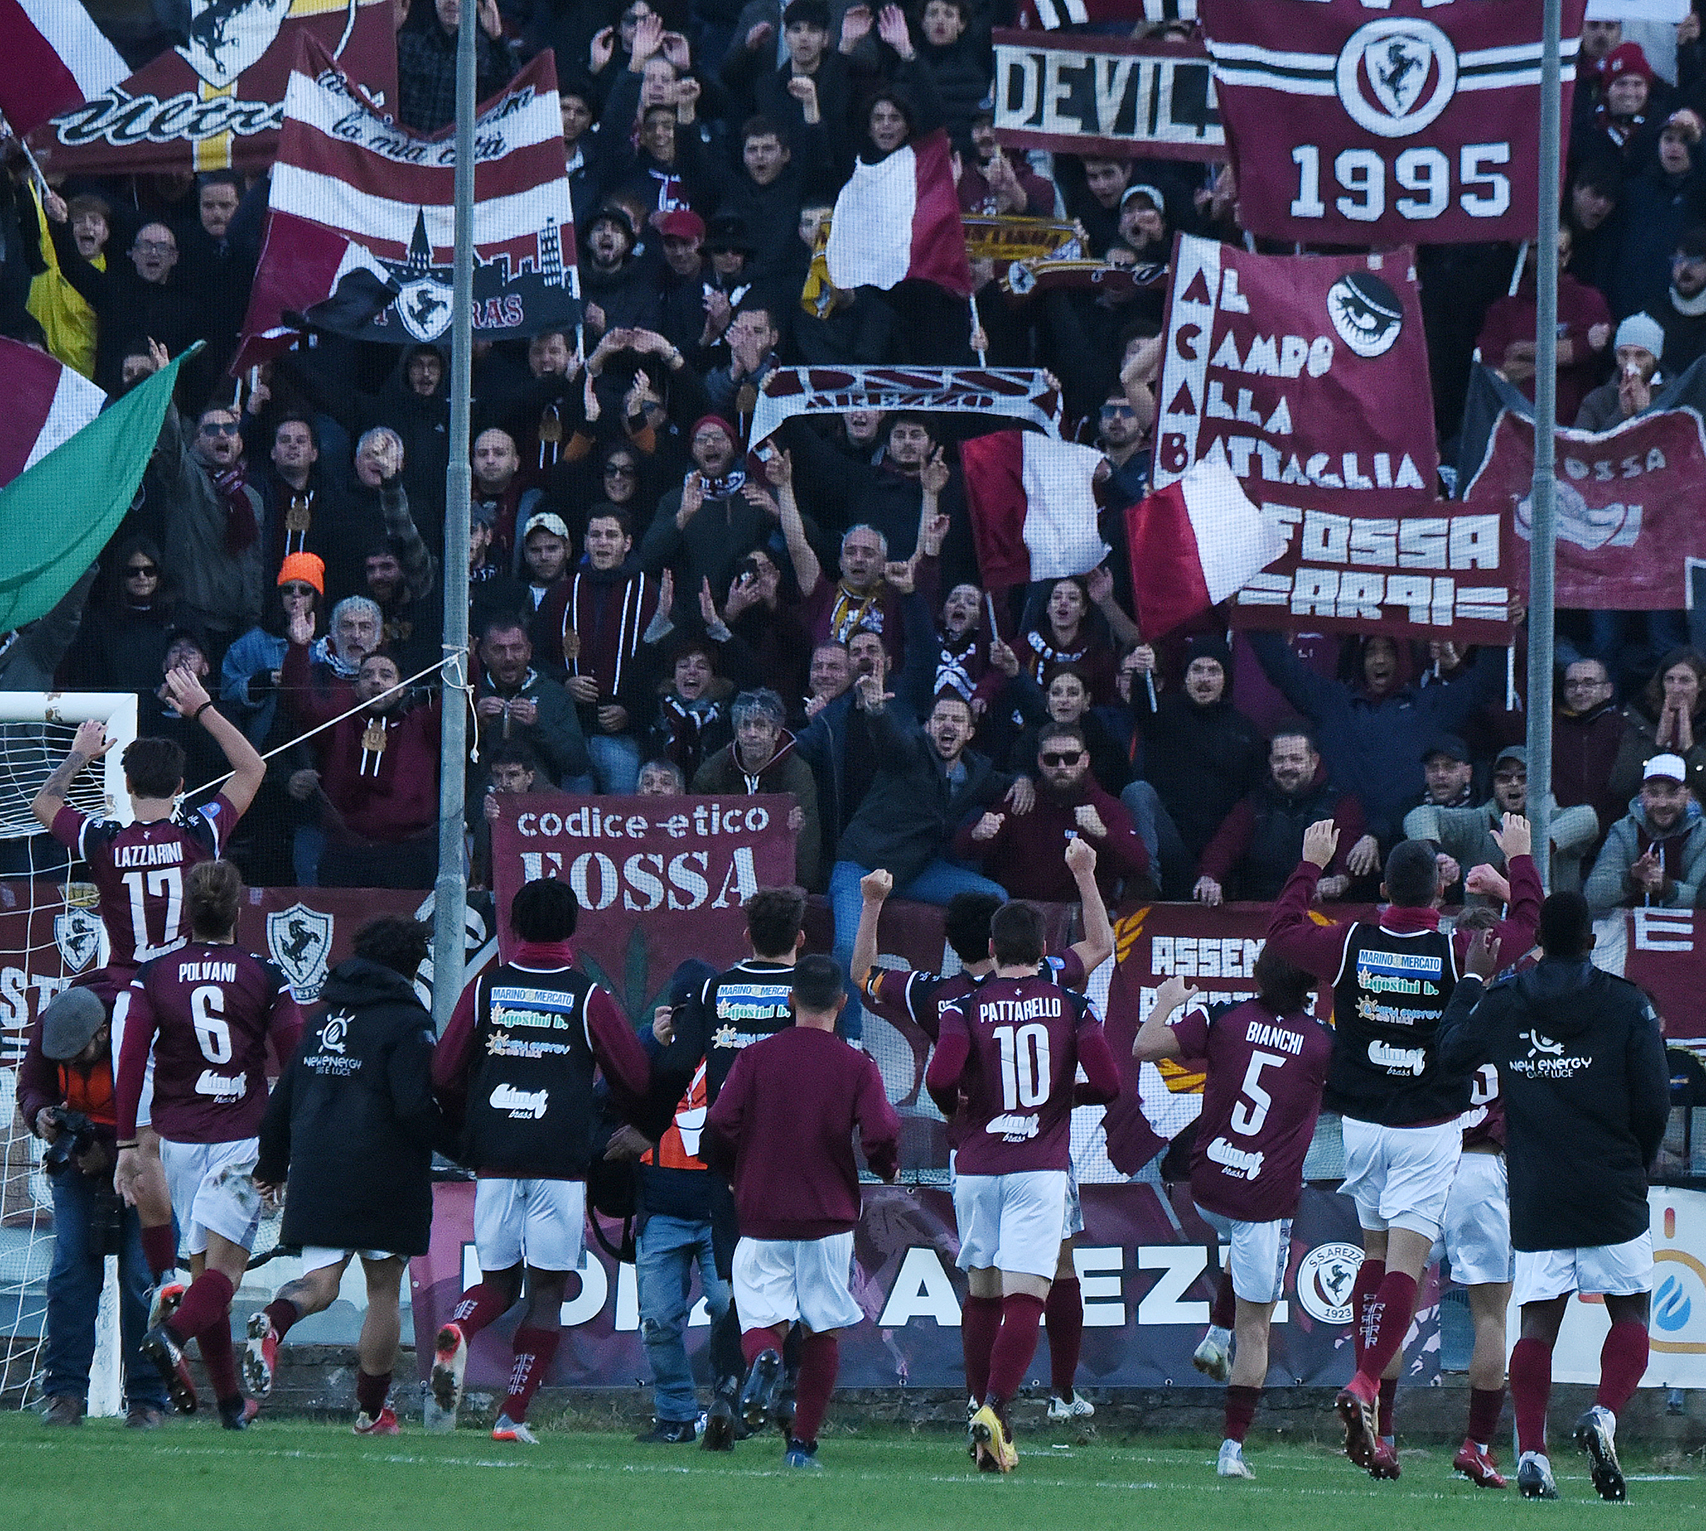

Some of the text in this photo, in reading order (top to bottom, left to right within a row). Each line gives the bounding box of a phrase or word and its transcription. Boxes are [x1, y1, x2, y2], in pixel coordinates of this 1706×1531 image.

[1290, 142, 1511, 222] 1995
[1181, 267, 1250, 314] AL
[1175, 323, 1334, 378] CAMPO
[1167, 378, 1293, 435] ALLA
[1558, 447, 1666, 481] OSSA
[1261, 501, 1500, 570] FOSSA
[517, 803, 770, 838] codice etico
[114, 842, 184, 868] LAZZARINI
[520, 847, 758, 911] FOSSA
[121, 866, 184, 945] 17
[178, 962, 236, 983] POLVANI
[1360, 950, 1440, 970] MARINO MERCATO
[492, 988, 573, 1006] MARINO MERCATO
[719, 985, 792, 996] MARINO MERCA
[191, 985, 233, 1065] 6
[979, 998, 1061, 1023] PATTARELLO
[1246, 1021, 1304, 1056] BIANCHI
[992, 1023, 1051, 1111] 10
[1550, 1068, 1574, 1078] LUCE
[1230, 1049, 1287, 1137] 5
[1324, 1308, 1352, 1319] 1923
